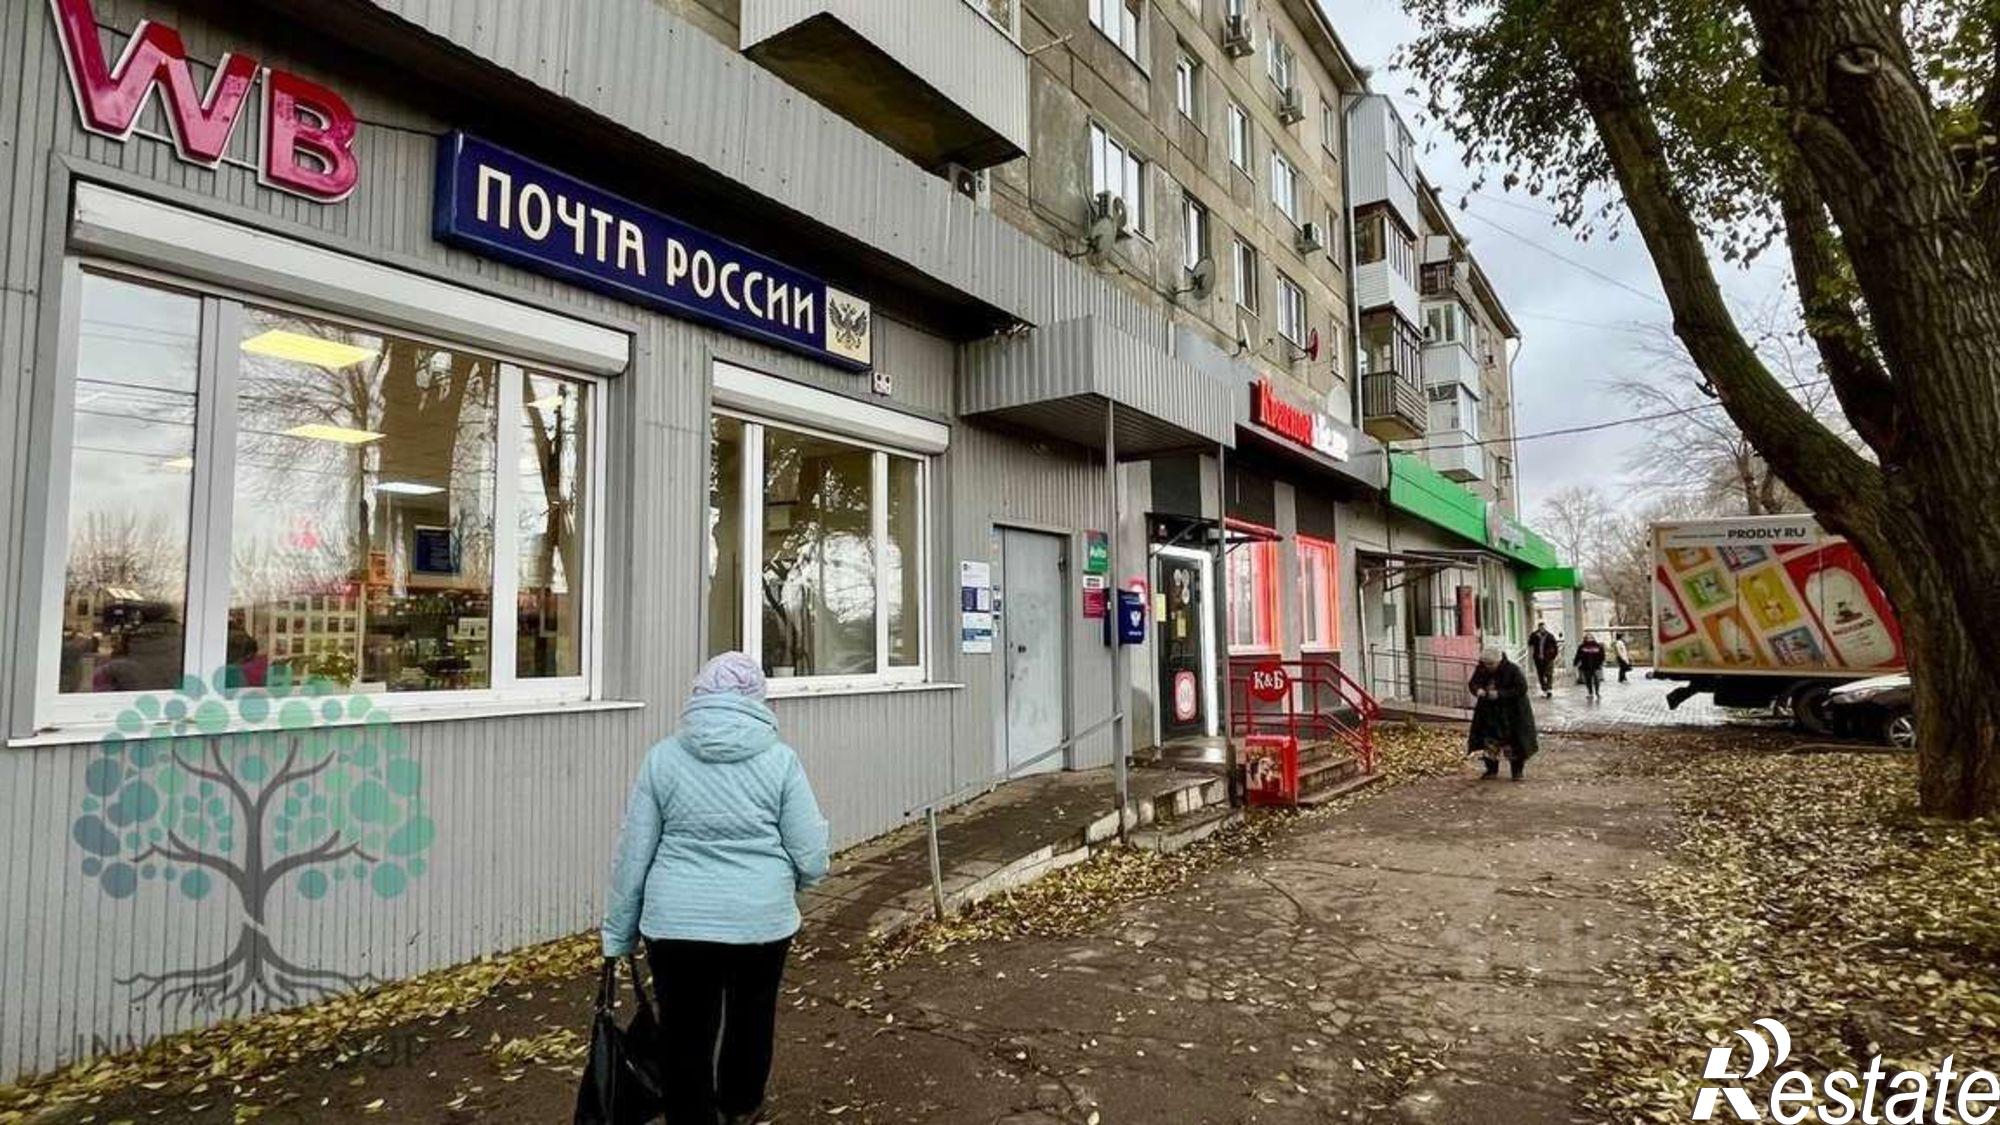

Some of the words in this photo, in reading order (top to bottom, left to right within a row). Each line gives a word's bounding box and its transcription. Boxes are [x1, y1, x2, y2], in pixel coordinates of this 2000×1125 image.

[50, 0, 359, 203] WB
[477, 164, 647, 276] ПОЧТА
[666, 237, 814, 334] РОССИИ
